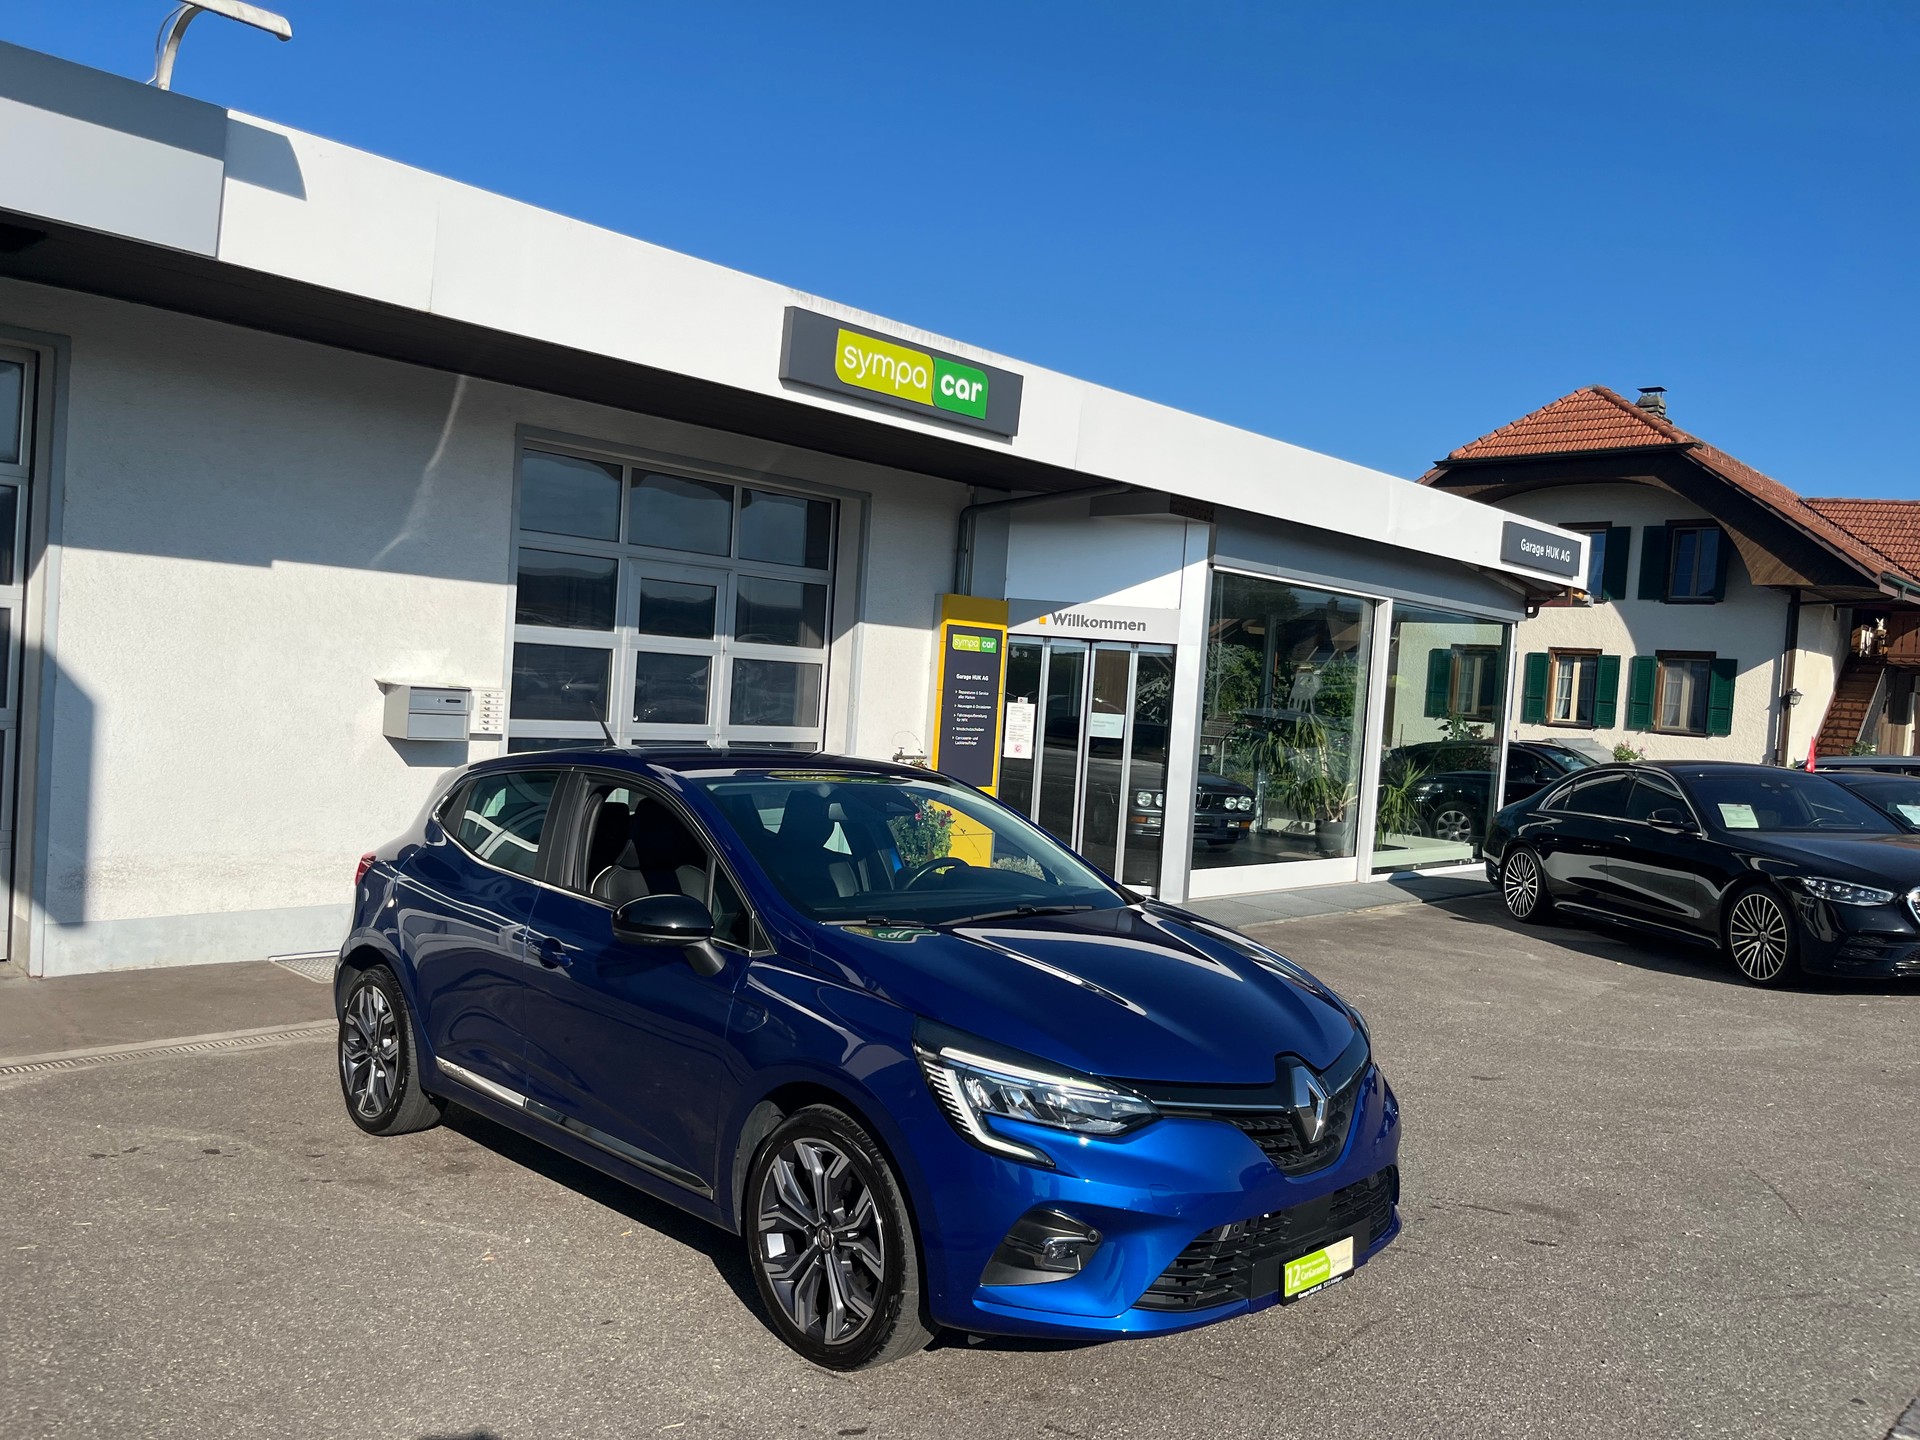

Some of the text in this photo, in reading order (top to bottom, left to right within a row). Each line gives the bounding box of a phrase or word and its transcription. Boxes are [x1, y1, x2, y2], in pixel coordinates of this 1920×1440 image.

[843, 345, 983, 403] sympa car
[1520, 538, 1570, 562] Garage HUK AG
[1051, 612, 1146, 632] Willkommen
[954, 638, 995, 649] sympa car
[955, 673, 971, 681] Garage
[1286, 1264, 1301, 1290] 12
